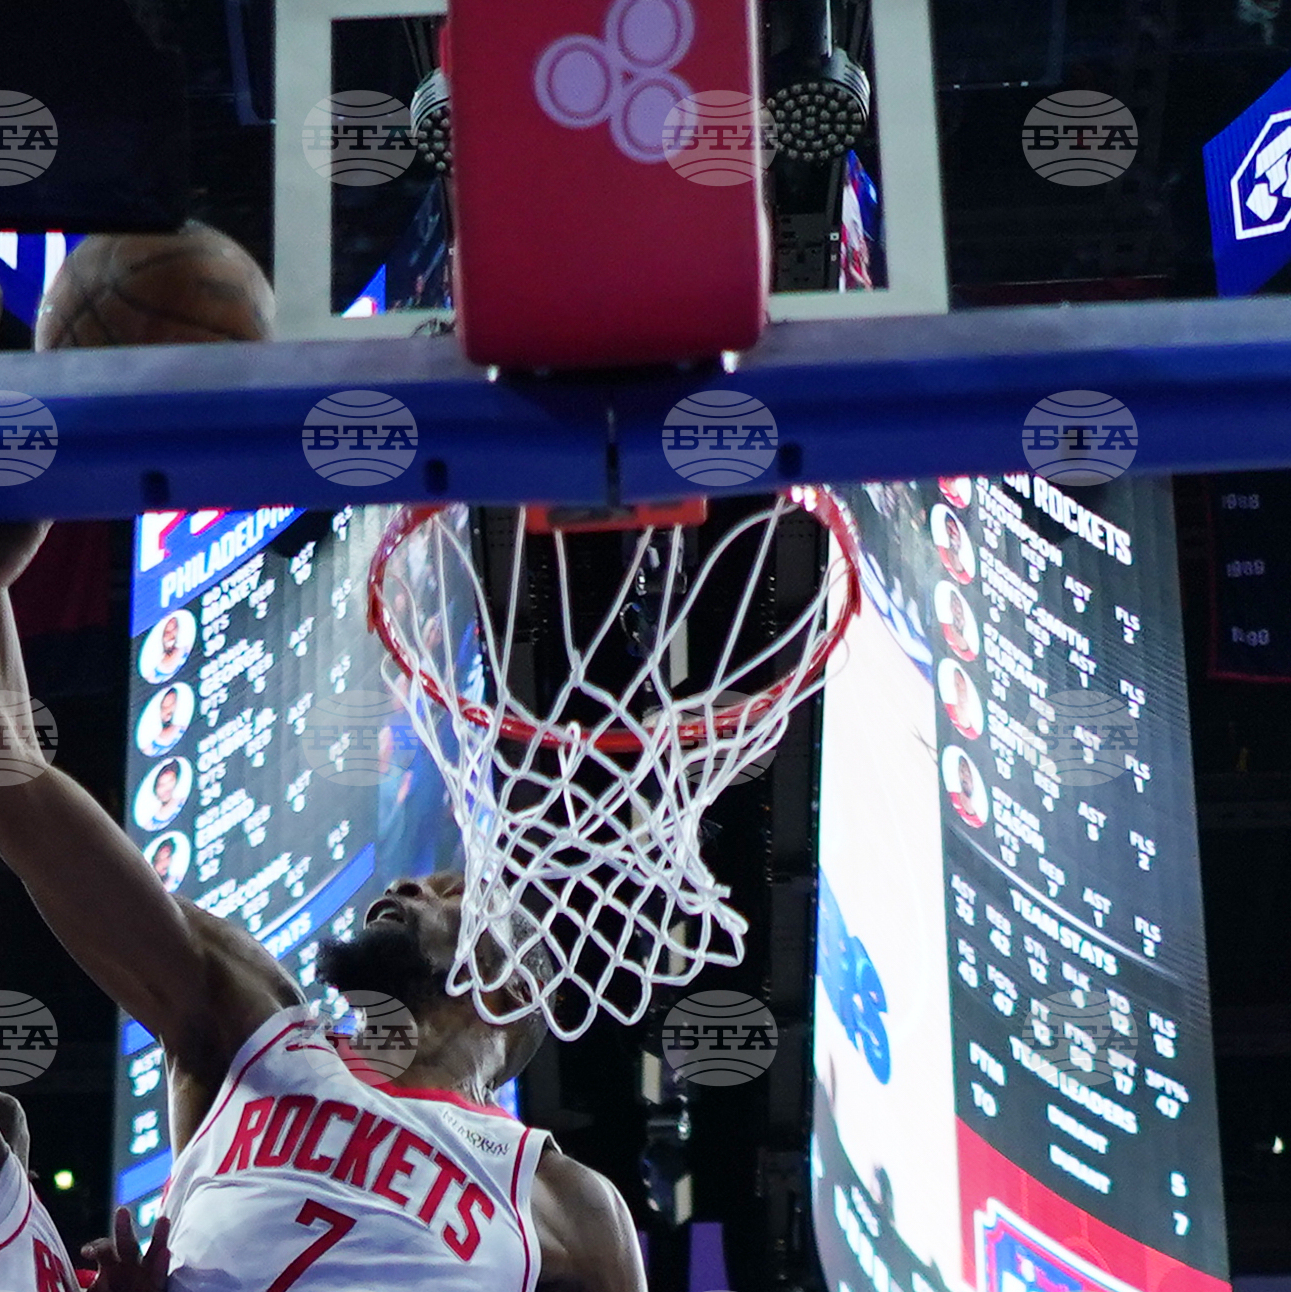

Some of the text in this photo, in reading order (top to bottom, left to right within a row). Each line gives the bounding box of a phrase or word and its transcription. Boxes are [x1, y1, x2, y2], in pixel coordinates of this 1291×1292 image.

[975, 487, 1063, 567] THOMPSON
[1033, 474, 1133, 566] ROCKETS
[978, 506, 1002, 536] PTS
[1064, 575, 1094, 602] AST
[1114, 604, 1141, 631] FLS
[980, 560, 1091, 656] FINNEY-SMITH
[982, 580, 1007, 612] PTS
[1069, 649, 1098, 675] AST
[1119, 678, 1146, 705] FLS
[984, 636, 1049, 699] DURANT
[1122, 626, 1135, 645] 2
[1128, 700, 1141, 719] 2
[1124, 753, 1151, 780] FLS
[992, 800, 1046, 855] EASON
[1077, 801, 1107, 829] AST
[1129, 829, 1156, 857] FLS
[1009, 888, 1118, 976] TEAM STATS
[1082, 886, 1113, 915] AST
[1133, 914, 1162, 944] FLS
[1023, 934, 1050, 966] STL
[1147, 1010, 1178, 1039] FLS
[1059, 1069, 1139, 1135] LEADERS
[214, 1093, 497, 1264] ROCKETS
[969, 1080, 1191, 1236] TO 7
